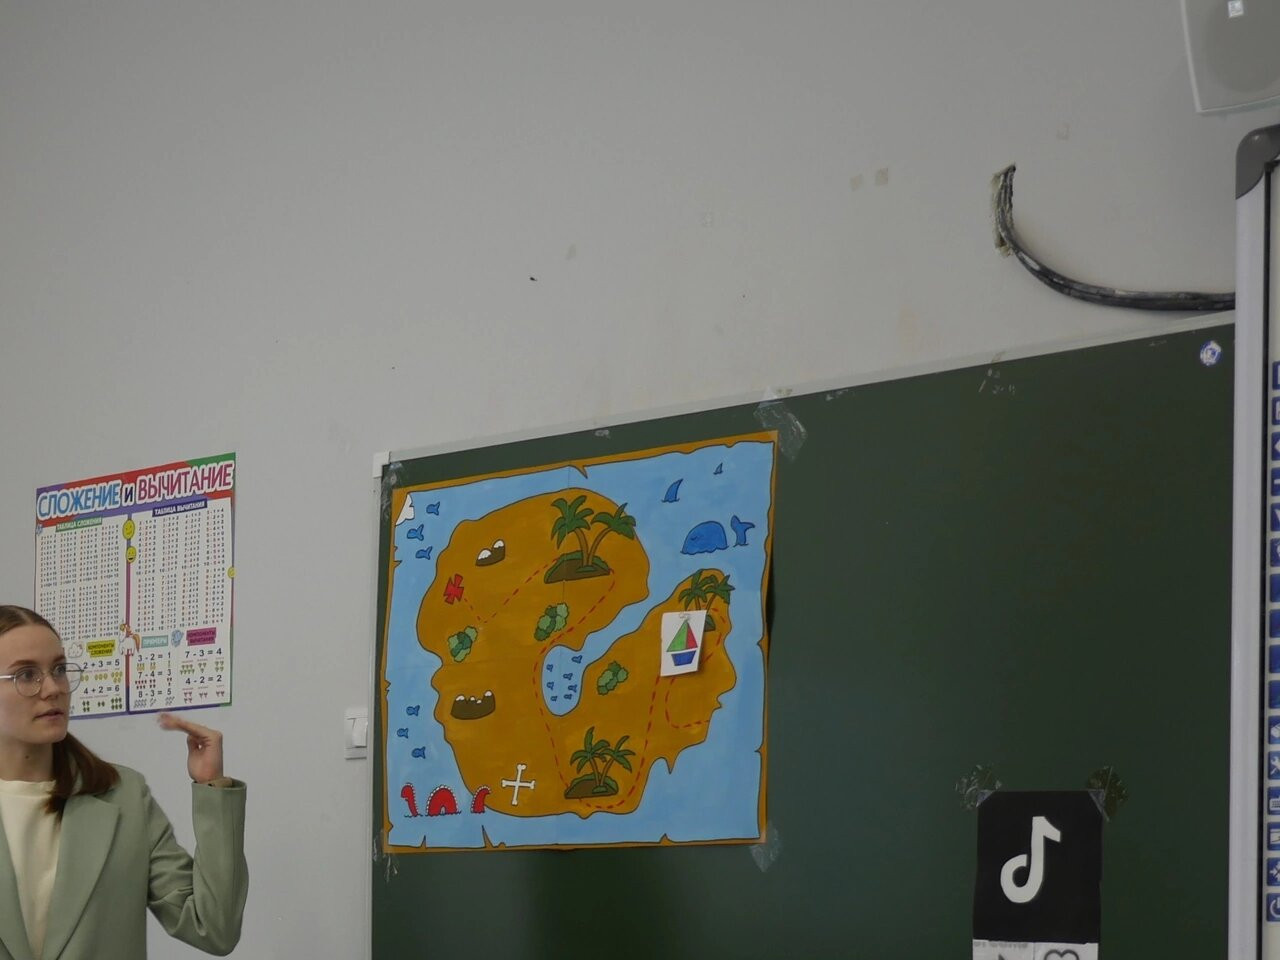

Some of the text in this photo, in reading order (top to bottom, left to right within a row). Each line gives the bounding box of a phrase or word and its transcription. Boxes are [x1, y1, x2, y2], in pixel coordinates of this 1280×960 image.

[38, 482, 121, 516] СЛОЖЕНИЕ
[138, 463, 233, 501] ВЫЧИТАНИЕ
[155, 505, 177, 516] ТАБЛИЦА
